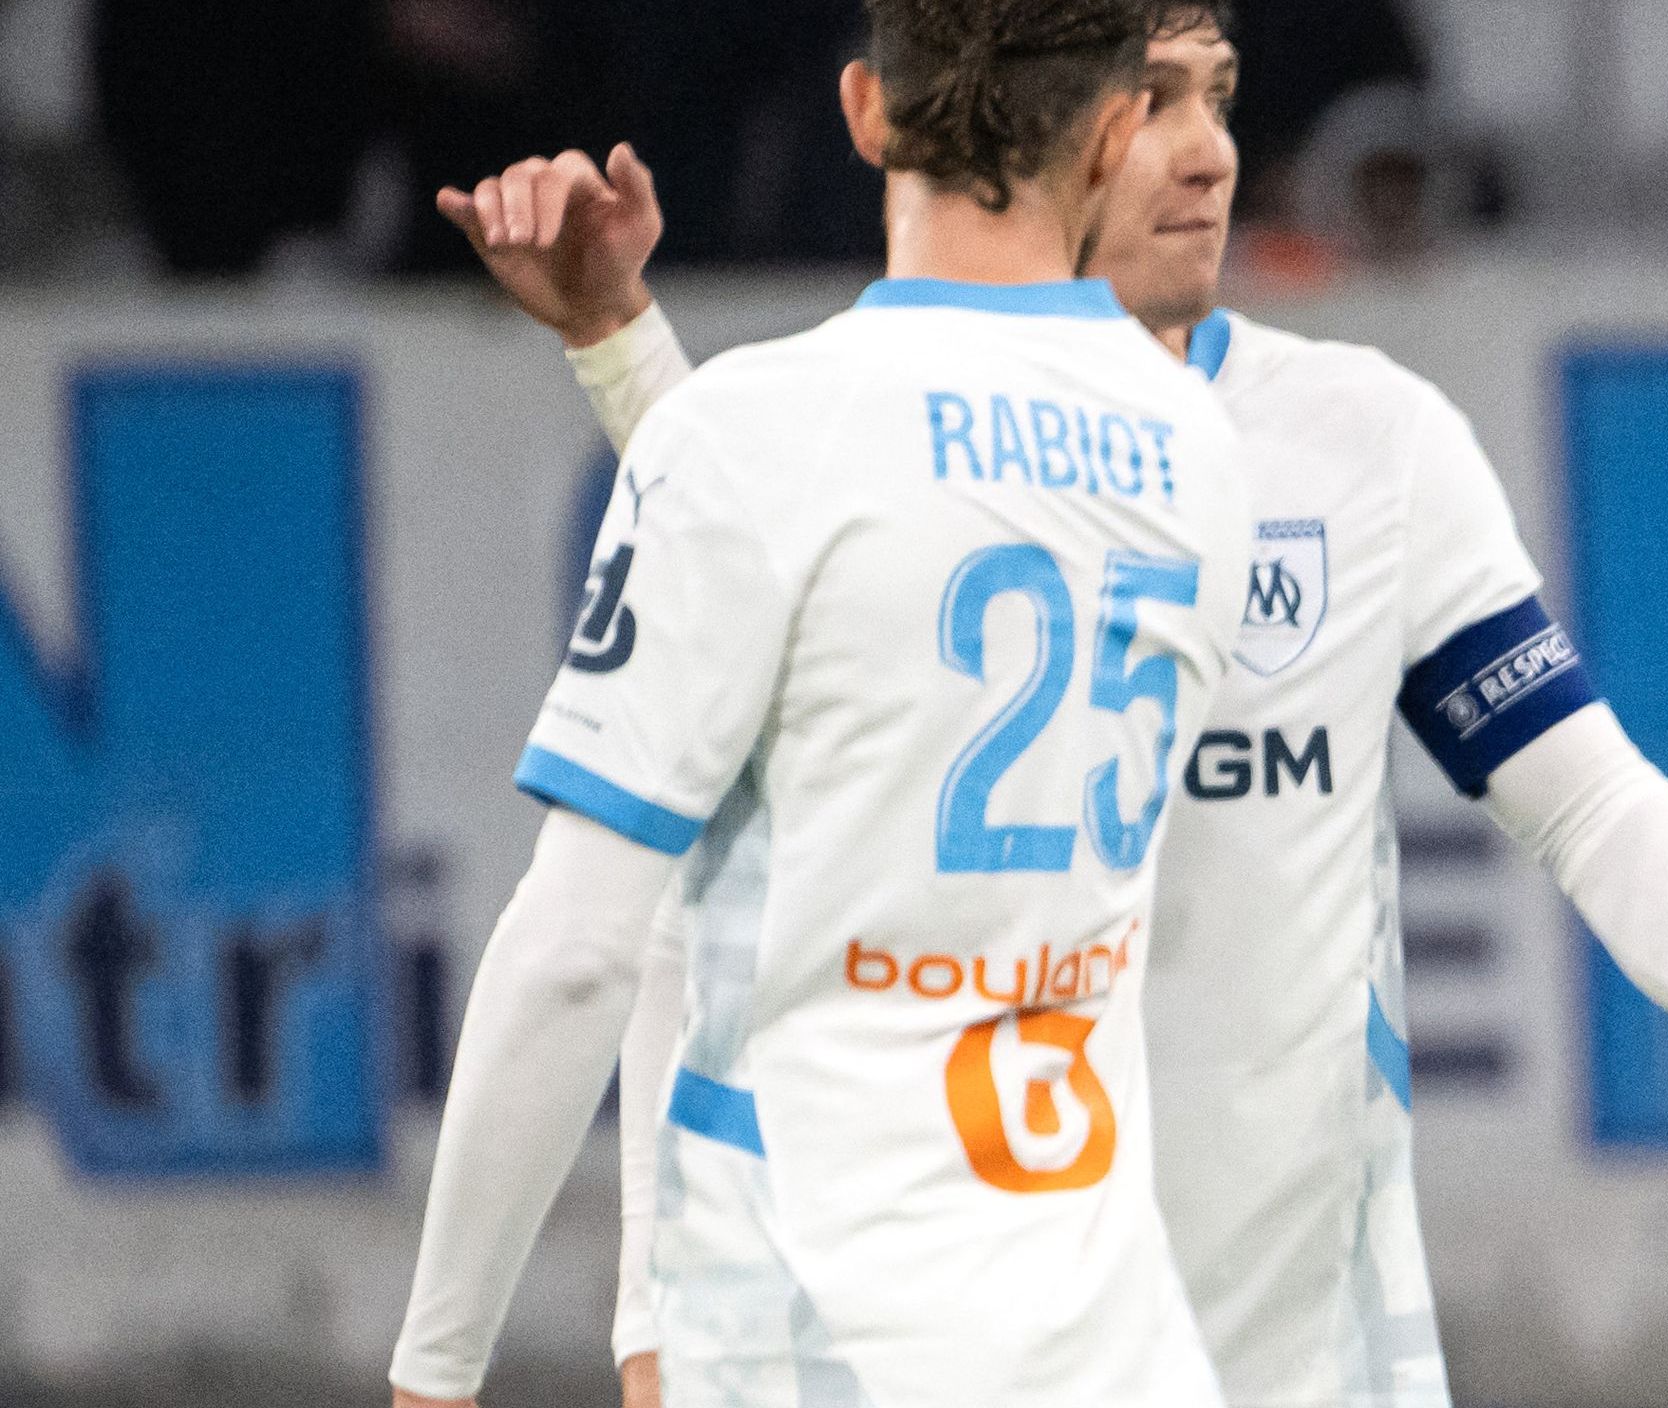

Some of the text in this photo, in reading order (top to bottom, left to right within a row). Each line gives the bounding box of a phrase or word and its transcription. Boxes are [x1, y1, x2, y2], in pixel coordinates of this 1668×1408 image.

[925, 391, 1174, 503] RABIOT
[936, 540, 1203, 873] 25
[1184, 725, 1333, 800] GM
